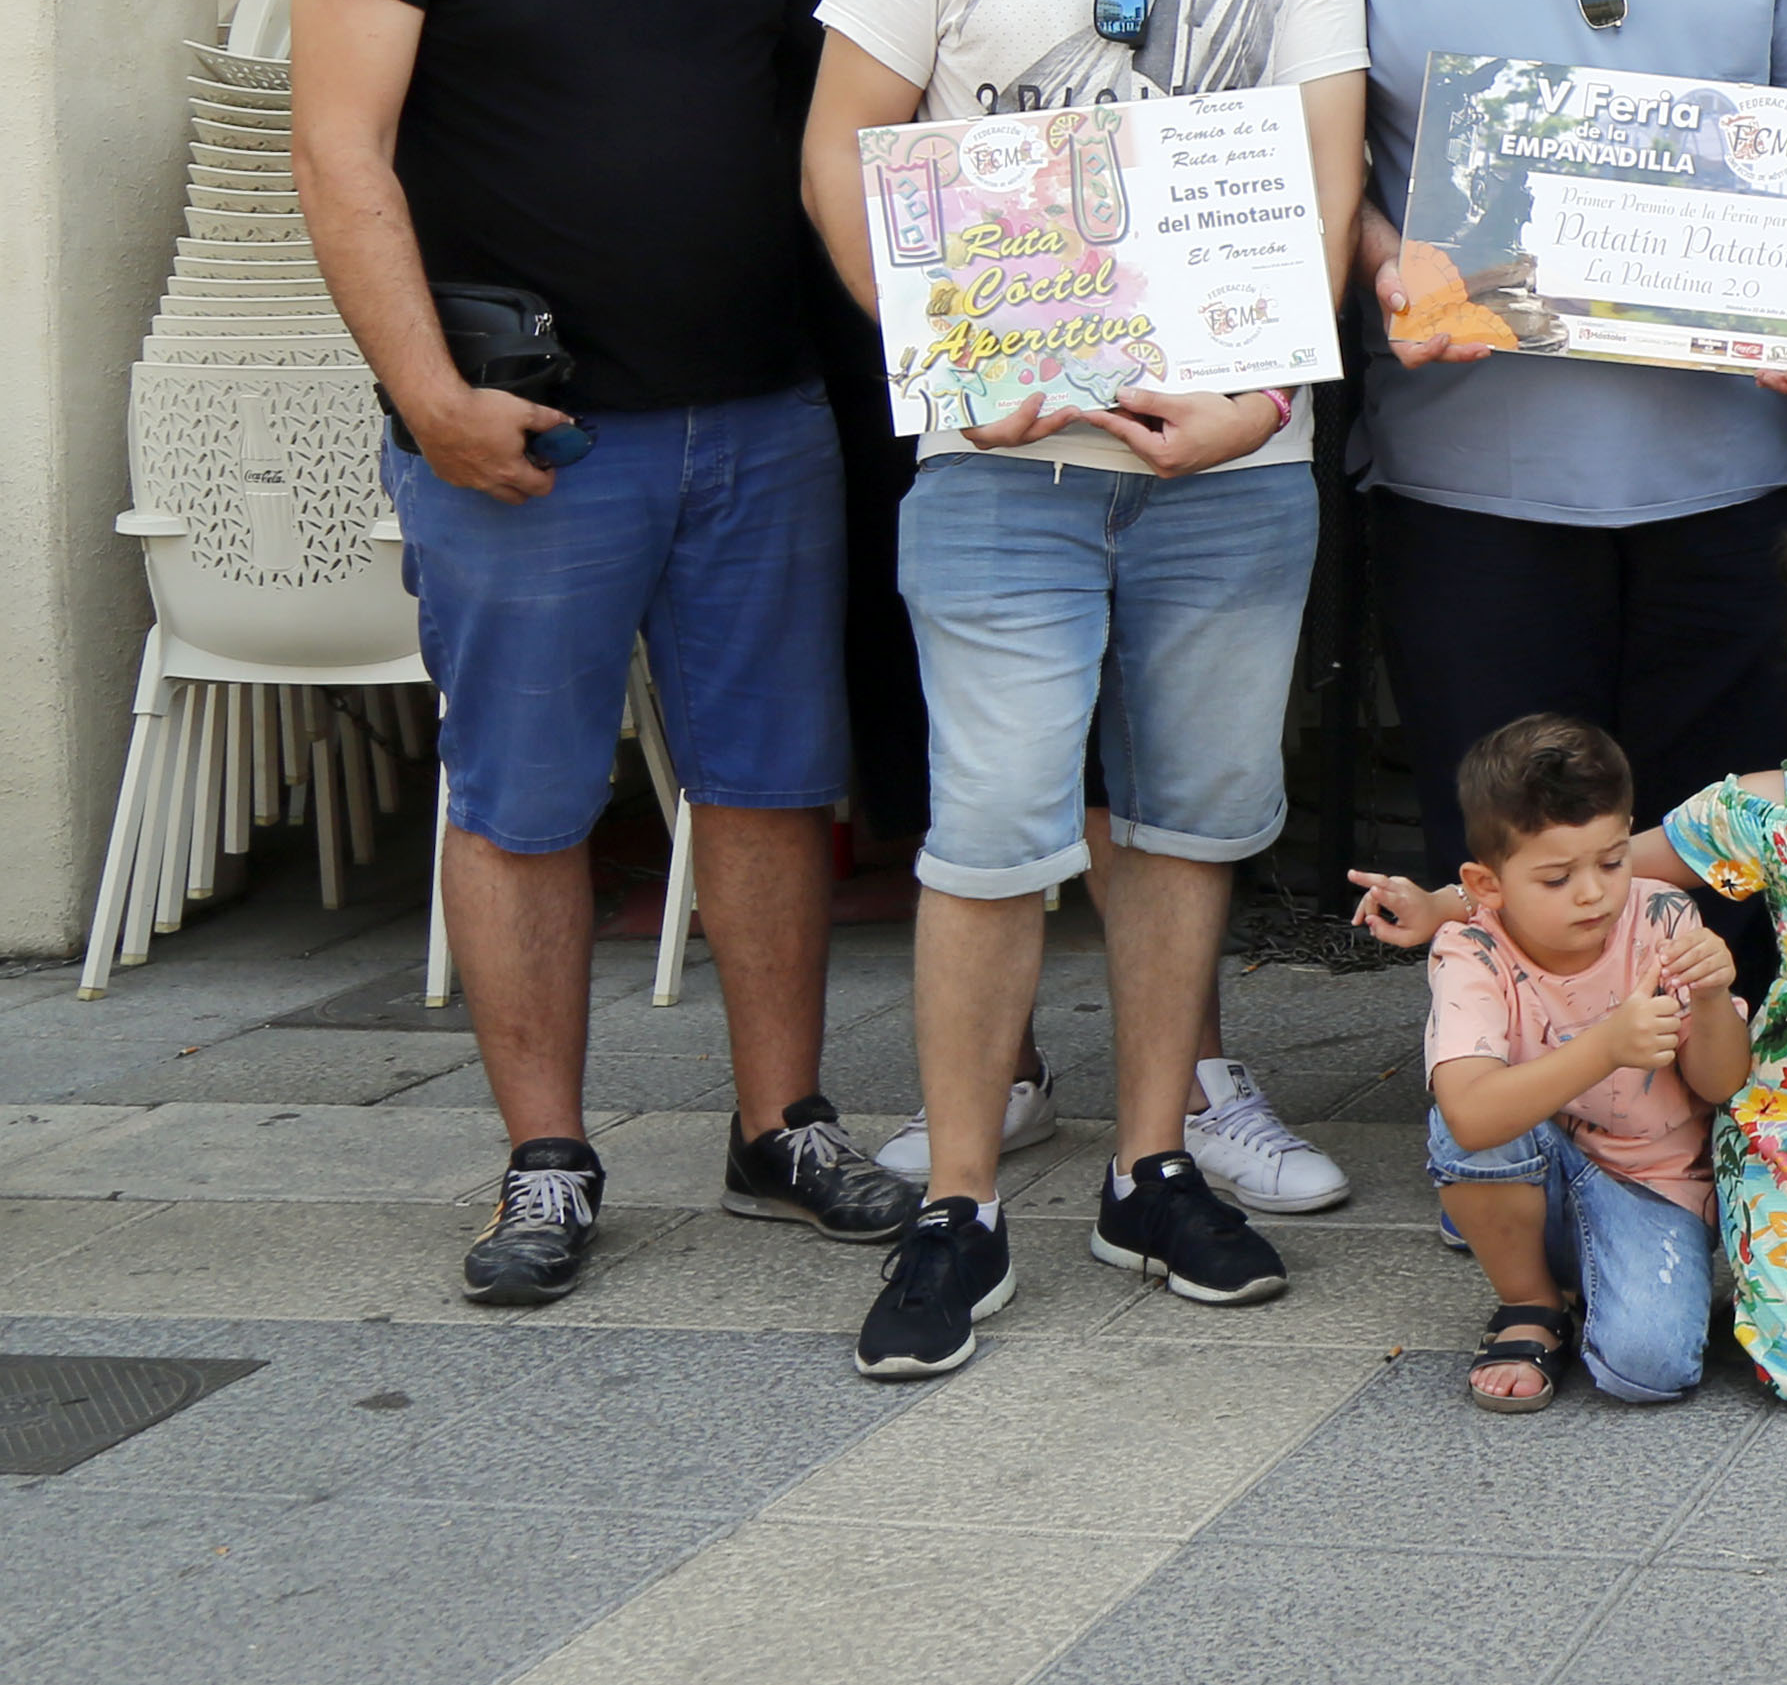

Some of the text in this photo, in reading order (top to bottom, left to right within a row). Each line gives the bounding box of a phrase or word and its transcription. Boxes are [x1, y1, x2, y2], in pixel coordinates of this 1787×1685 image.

[1189, 98, 1245, 114] Tercer
[1538, 78, 1700, 130] V Feria
[1161, 120, 1280, 145] Premio de la
[1576, 121, 1627, 143] de la
[1171, 147, 1275, 169] Ruta para:
[1500, 134, 1696, 175] EMPANADILLA
[1170, 177, 1285, 202] Las Torres
[1561, 187, 1618, 209] Primer
[1623, 191, 1676, 216] Premio
[1680, 202, 1698, 218] de
[1702, 203, 1717, 219] la
[1720, 205, 1759, 227] Feria
[1158, 203, 1305, 234] del Minotauro
[1554, 212, 1670, 254] Patatín
[960, 224, 1066, 262] Ruta
[1187, 241, 1287, 266] El Torreón
[962, 258, 1116, 315] Cóctel
[1584, 259, 1761, 299] La Patatina 2.0
[924, 314, 1154, 370] Aperitivo
